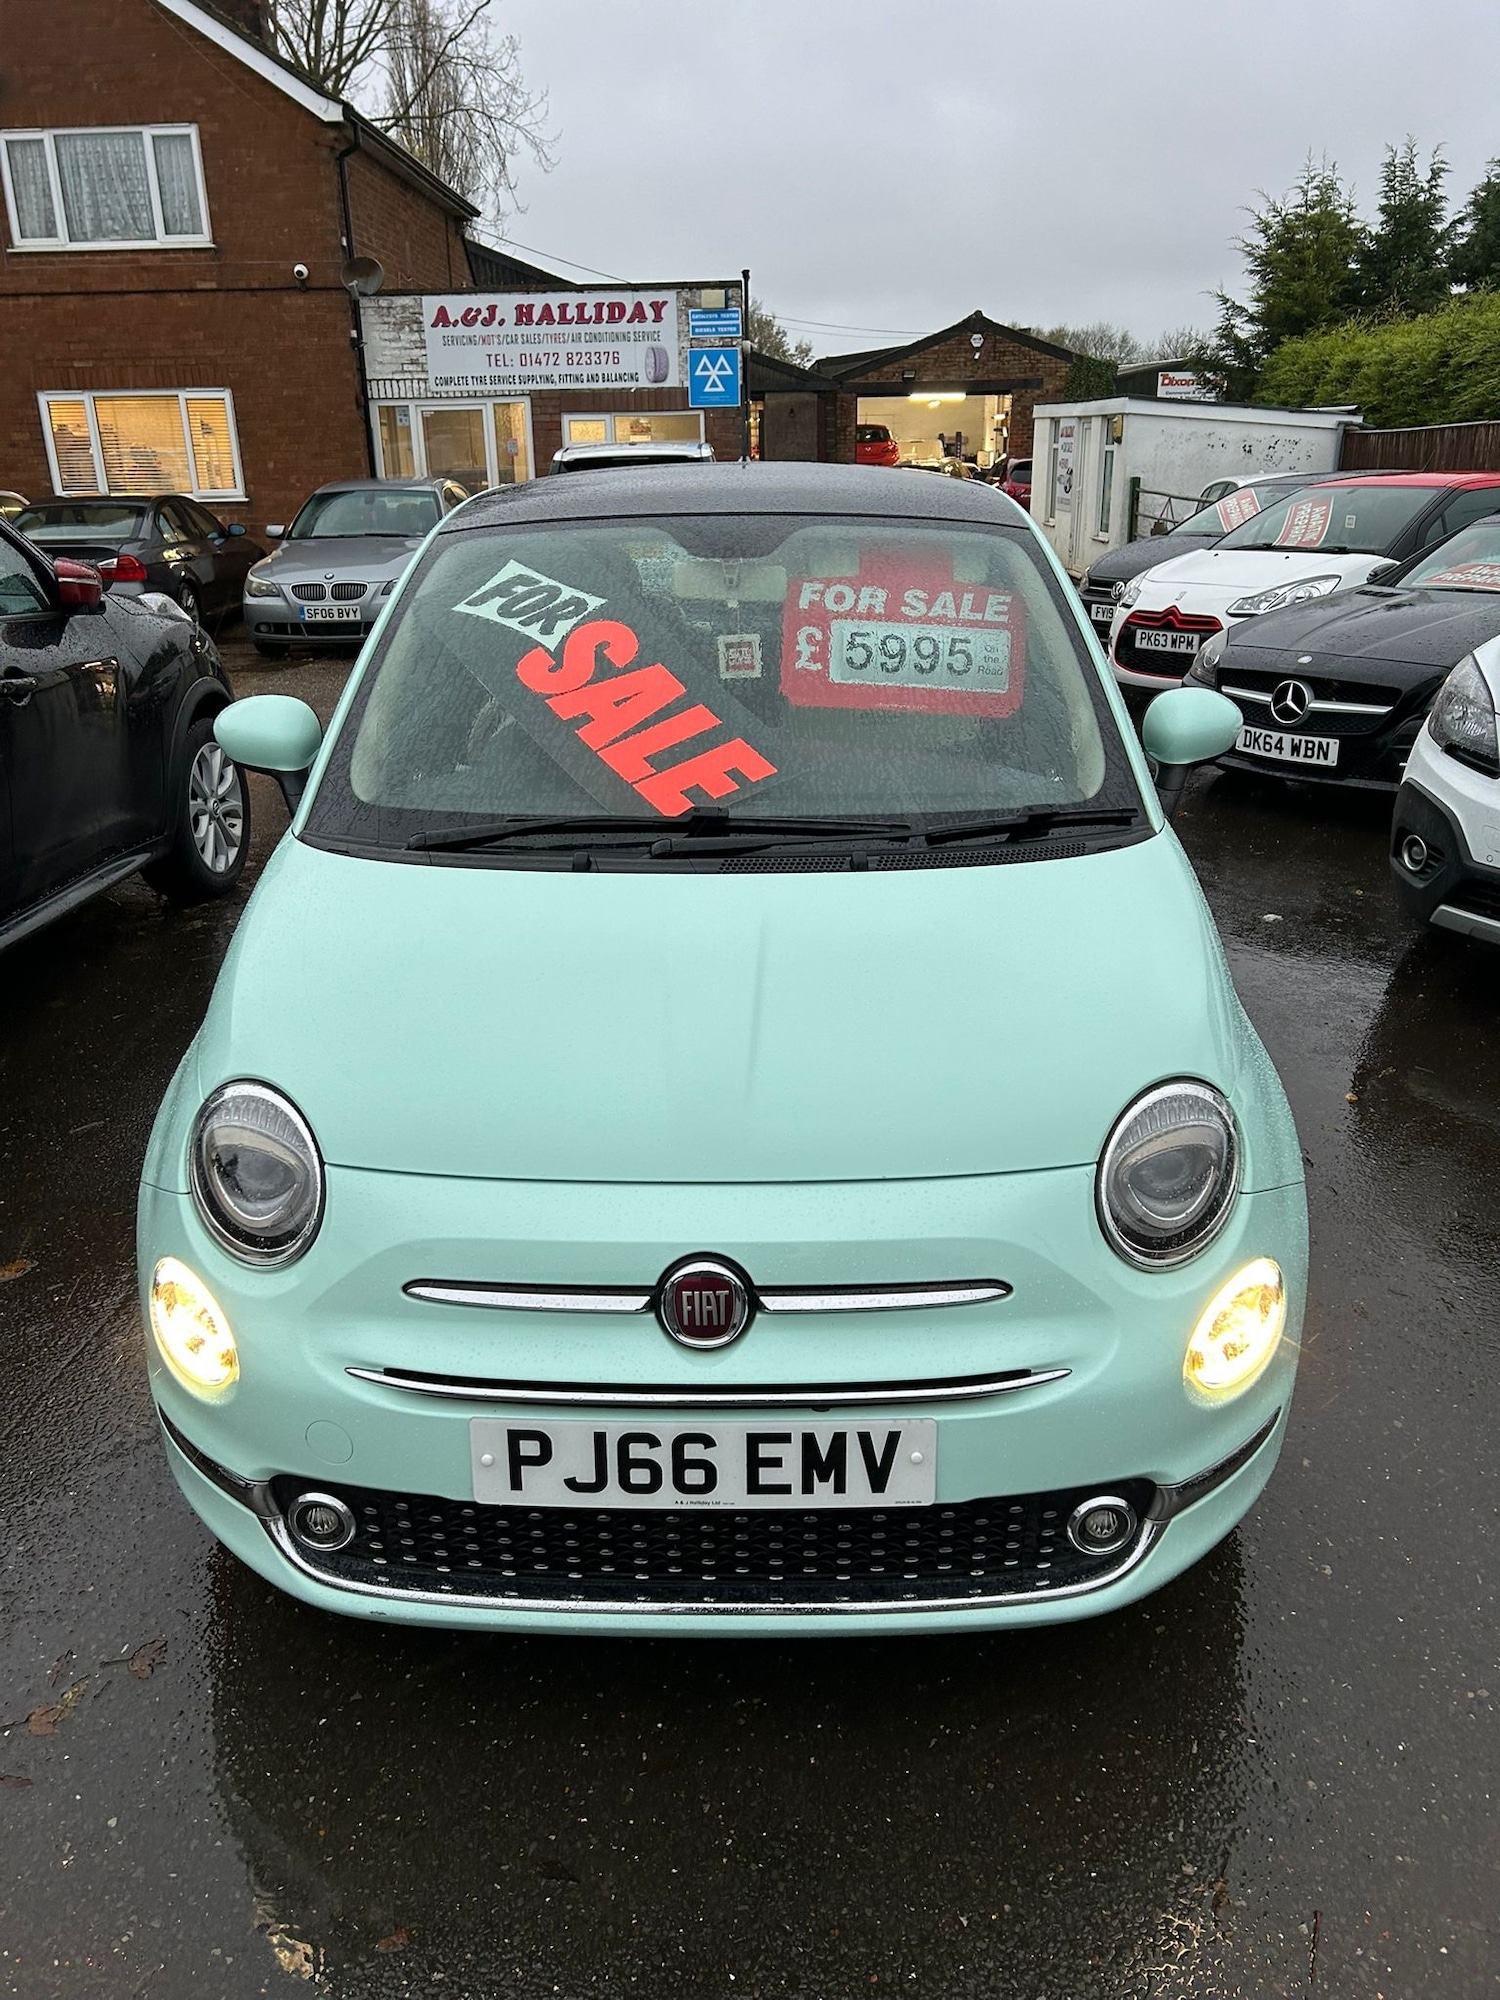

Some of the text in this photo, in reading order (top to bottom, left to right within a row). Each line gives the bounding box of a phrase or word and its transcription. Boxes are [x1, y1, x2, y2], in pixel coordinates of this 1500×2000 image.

[514, 300, 669, 327] HALLIDAY
[584, 331, 631, 344] CONDITIONING
[633, 330, 662, 342] SERVICE
[486, 350, 620, 368] TEL: 01472 823376
[434, 371, 640, 387] COMPLETE TYRE SERVICE SUPPLYING, FITTING AND BALANCING
[306, 607, 358, 619] SF06 BVY
[463, 573, 590, 637] FOR
[799, 581, 1013, 623] FOR SALE
[795, 626, 973, 676] £ 5995
[1139, 631, 1168, 648] PK63
[977, 665, 1004, 676] Road
[983, 654, 1000, 664] the
[515, 620, 778, 818] SALE
[1243, 729, 1330, 761] DK64 WBN
[681, 1290, 730, 1327] FIAT
[506, 1428, 902, 1496] PJ66 EMV
